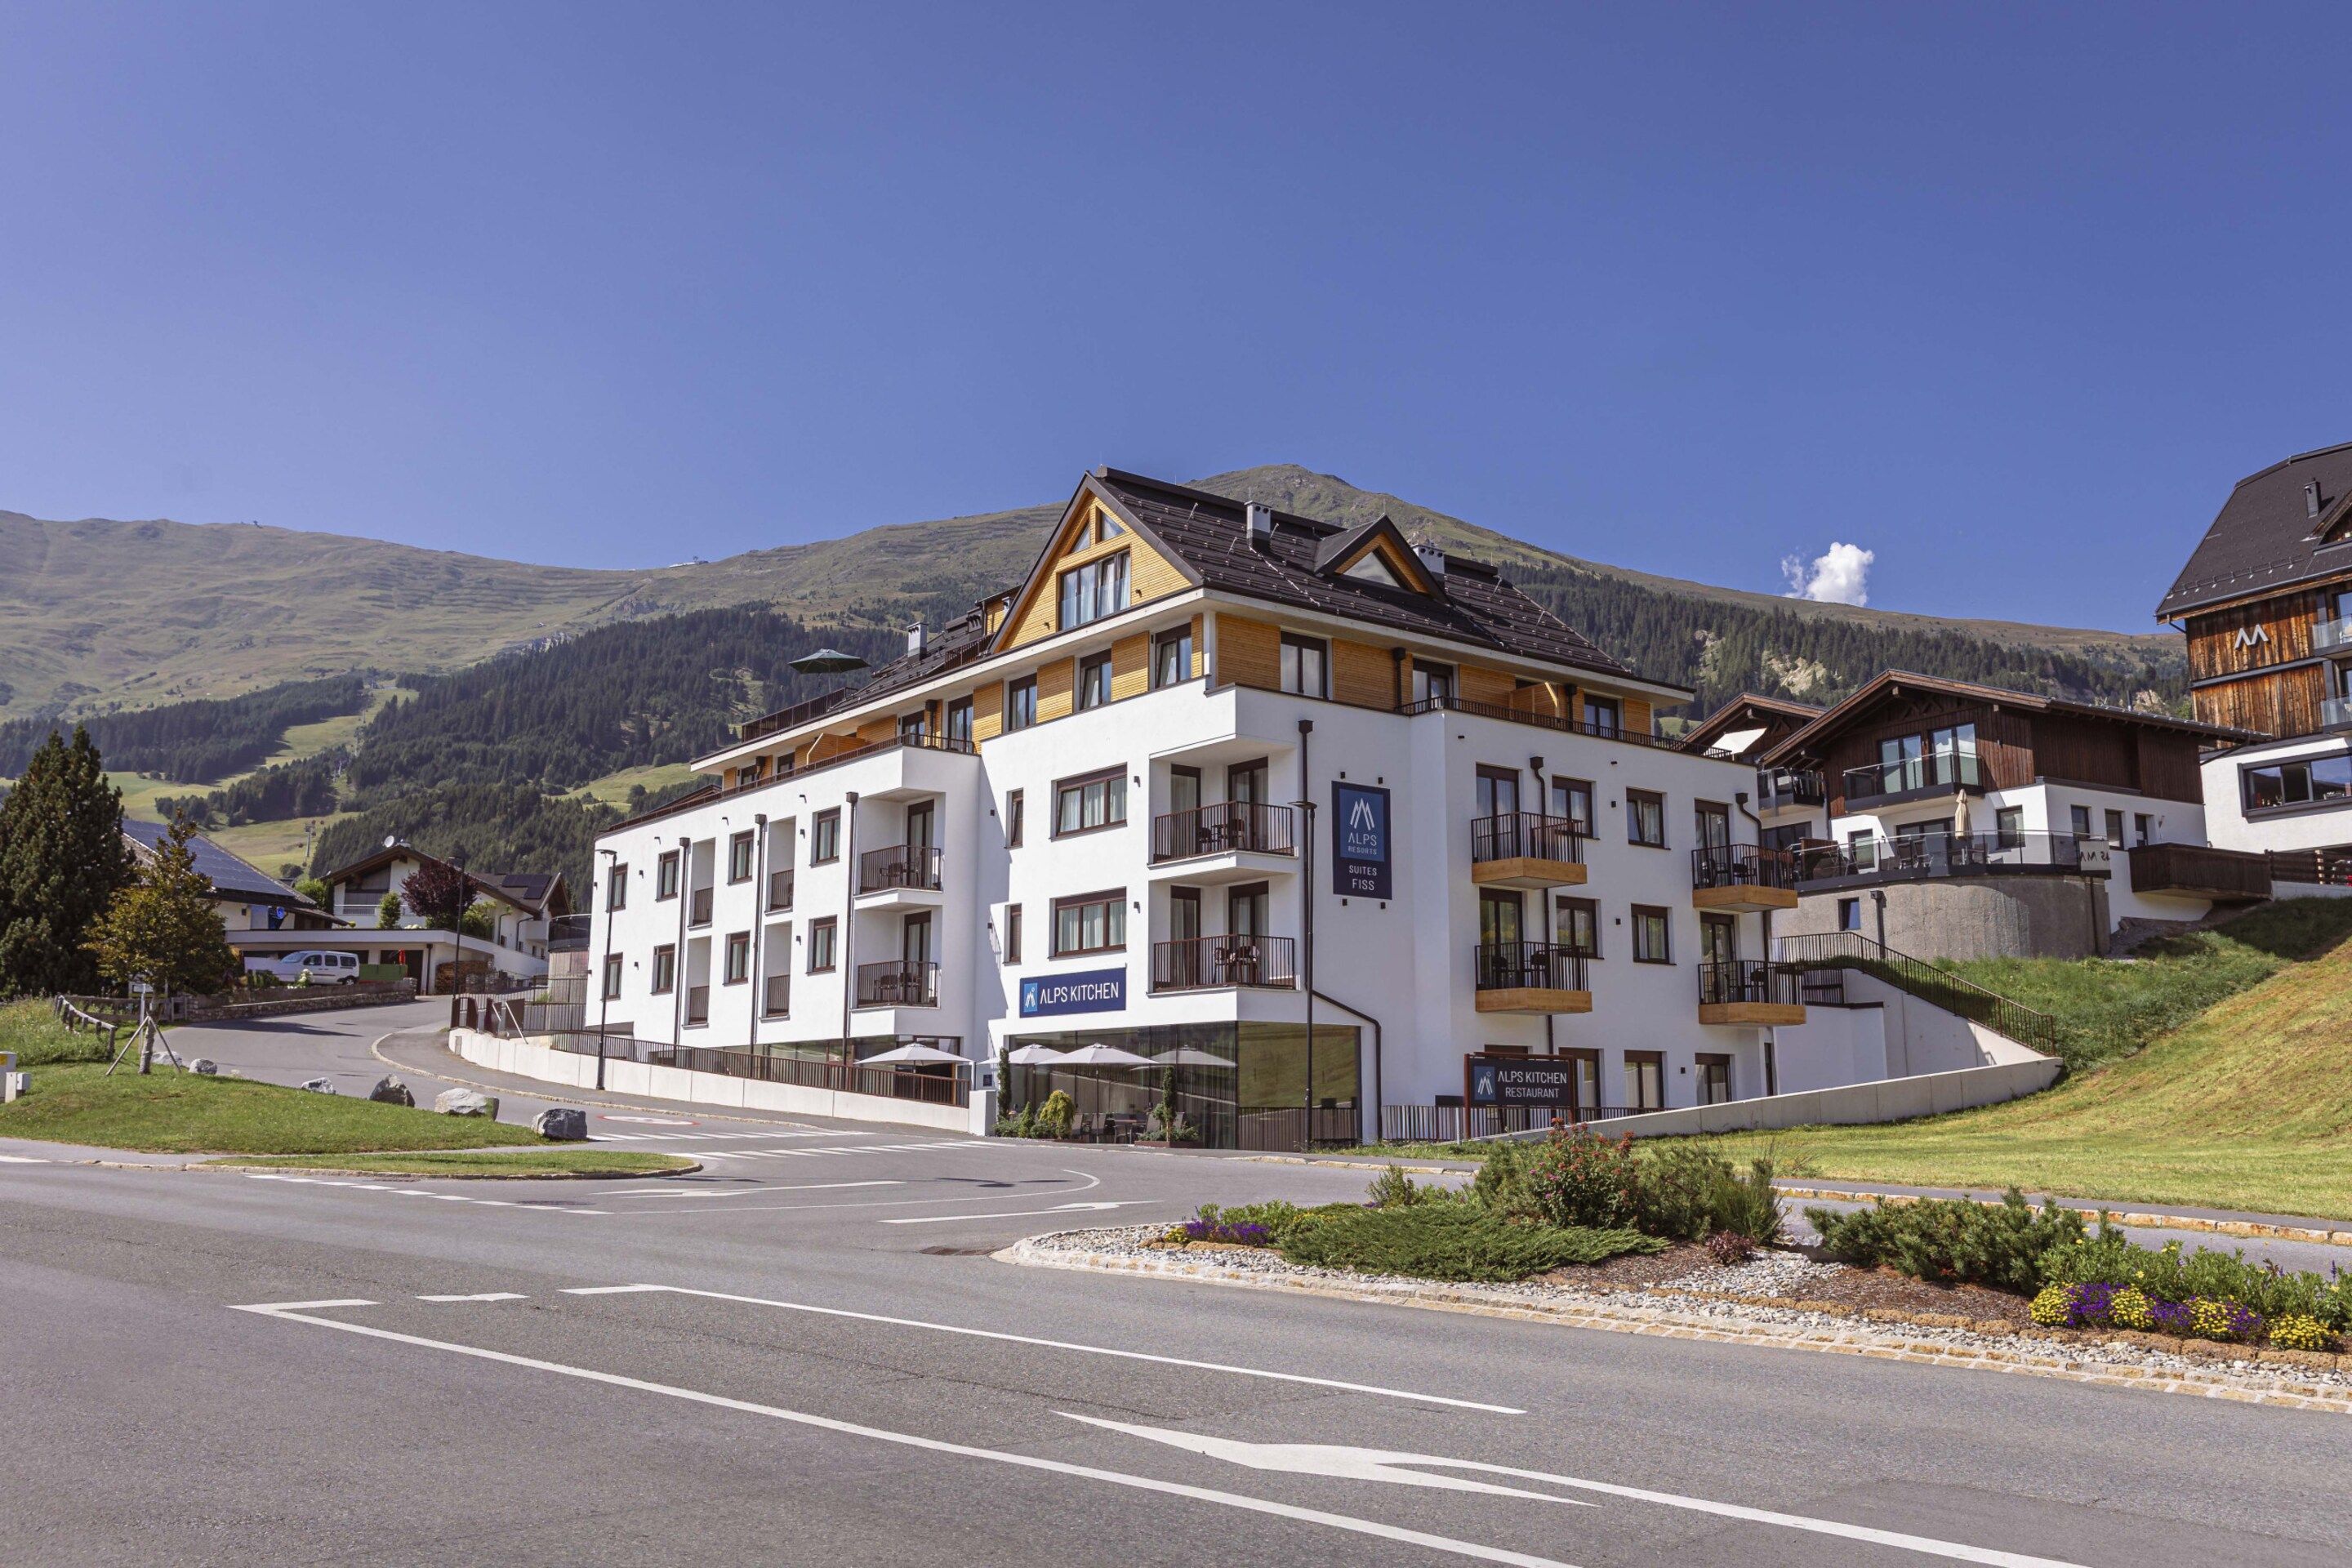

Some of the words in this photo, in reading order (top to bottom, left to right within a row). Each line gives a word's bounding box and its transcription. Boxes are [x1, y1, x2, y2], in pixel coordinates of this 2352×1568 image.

[1348, 832, 1377, 846] ALPS
[1348, 846, 1377, 855] RESORTS
[1349, 865, 1377, 876] SUITES
[1352, 879, 1374, 891] FISS
[1040, 987, 1067, 1004] ALPS
[1071, 982, 1119, 1001] KITCHEN
[1498, 1071, 1523, 1083] ALPS
[1526, 1071, 1567, 1084] KITCHEN
[1505, 1087, 1560, 1098] RESTAURANT
